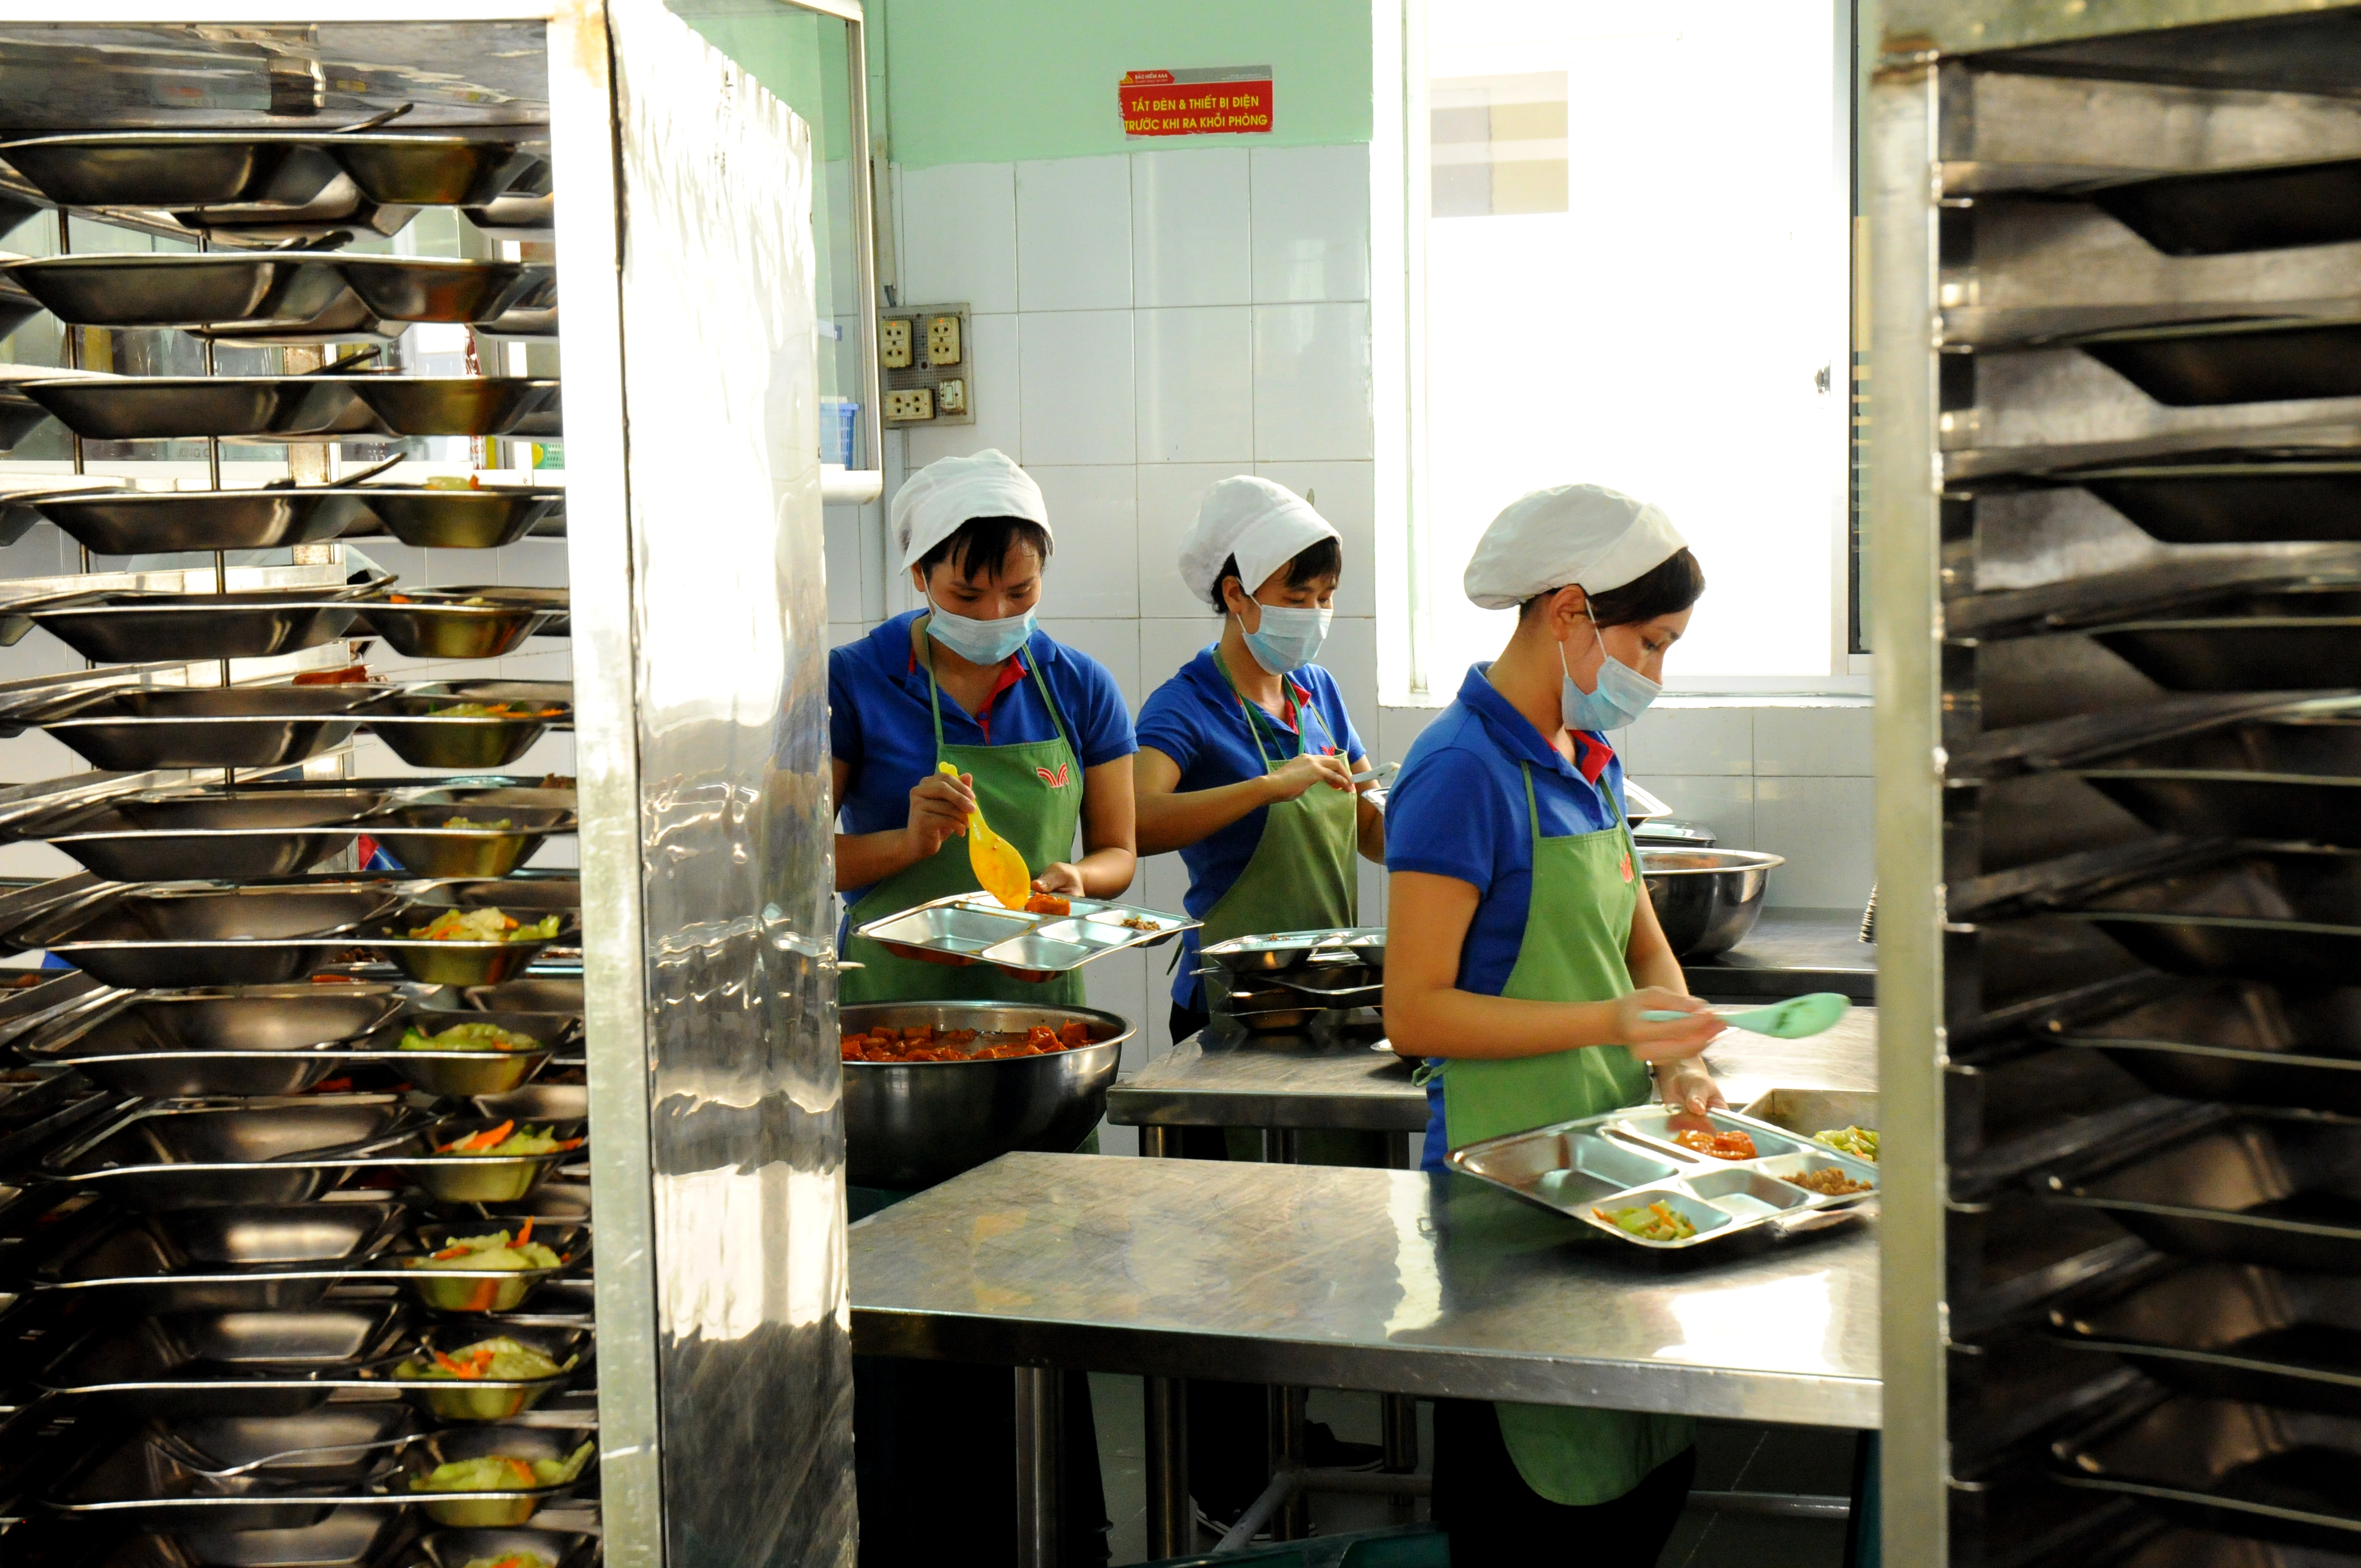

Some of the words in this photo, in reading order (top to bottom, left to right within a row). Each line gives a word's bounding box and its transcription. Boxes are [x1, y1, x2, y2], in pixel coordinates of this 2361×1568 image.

[1131, 96, 1150, 112] TẮT
[1153, 97, 1176, 111] ĐÈN
[1179, 99, 1186, 110] &
[1189, 94, 1216, 109] THIẾT
[1220, 97, 1229, 110] BỊ
[1233, 94, 1259, 109] ĐIỆN
[1124, 117, 1160, 130] TRƯỚC
[1163, 118, 1179, 129] KHI
[1183, 117, 1197, 128] RA
[1200, 112, 1225, 128] KHỎI
[1228, 112, 1267, 127] PHÒNG
